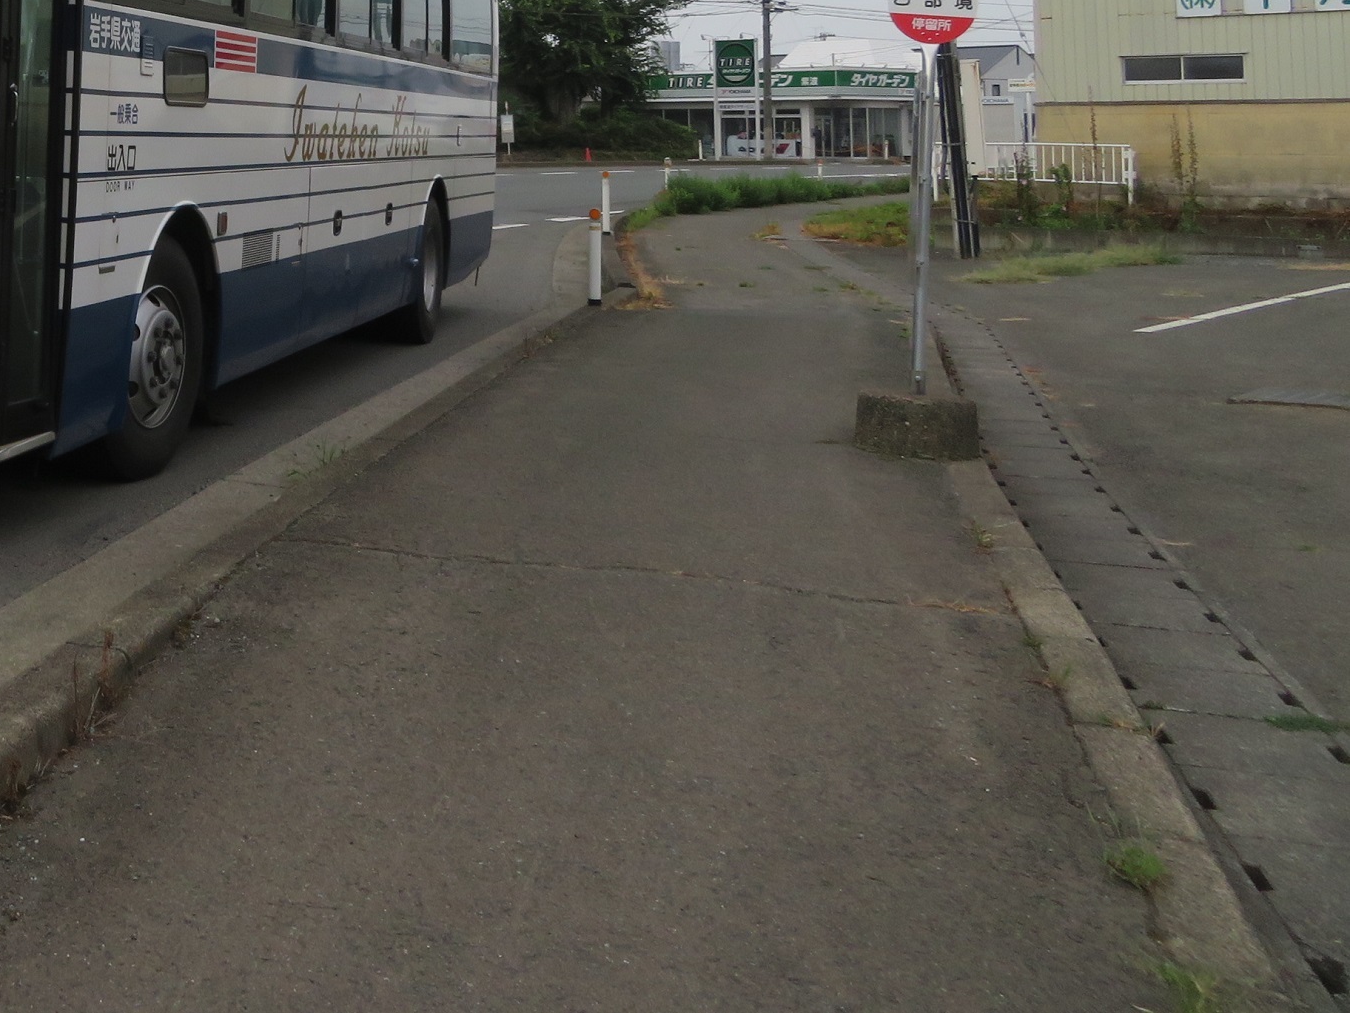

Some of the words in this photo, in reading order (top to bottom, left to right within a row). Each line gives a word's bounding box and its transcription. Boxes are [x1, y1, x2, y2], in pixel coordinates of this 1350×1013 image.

[912, 17, 952, 32] 停留所
[89, 12, 141, 53] 岩手県交通
[720, 57, 751, 67] TIRE
[668, 76, 703, 88] TIRE
[850, 73, 910, 88] タイヤガーデン
[110, 103, 139, 125] 一般乗合
[107, 144, 137, 171] 出入口
